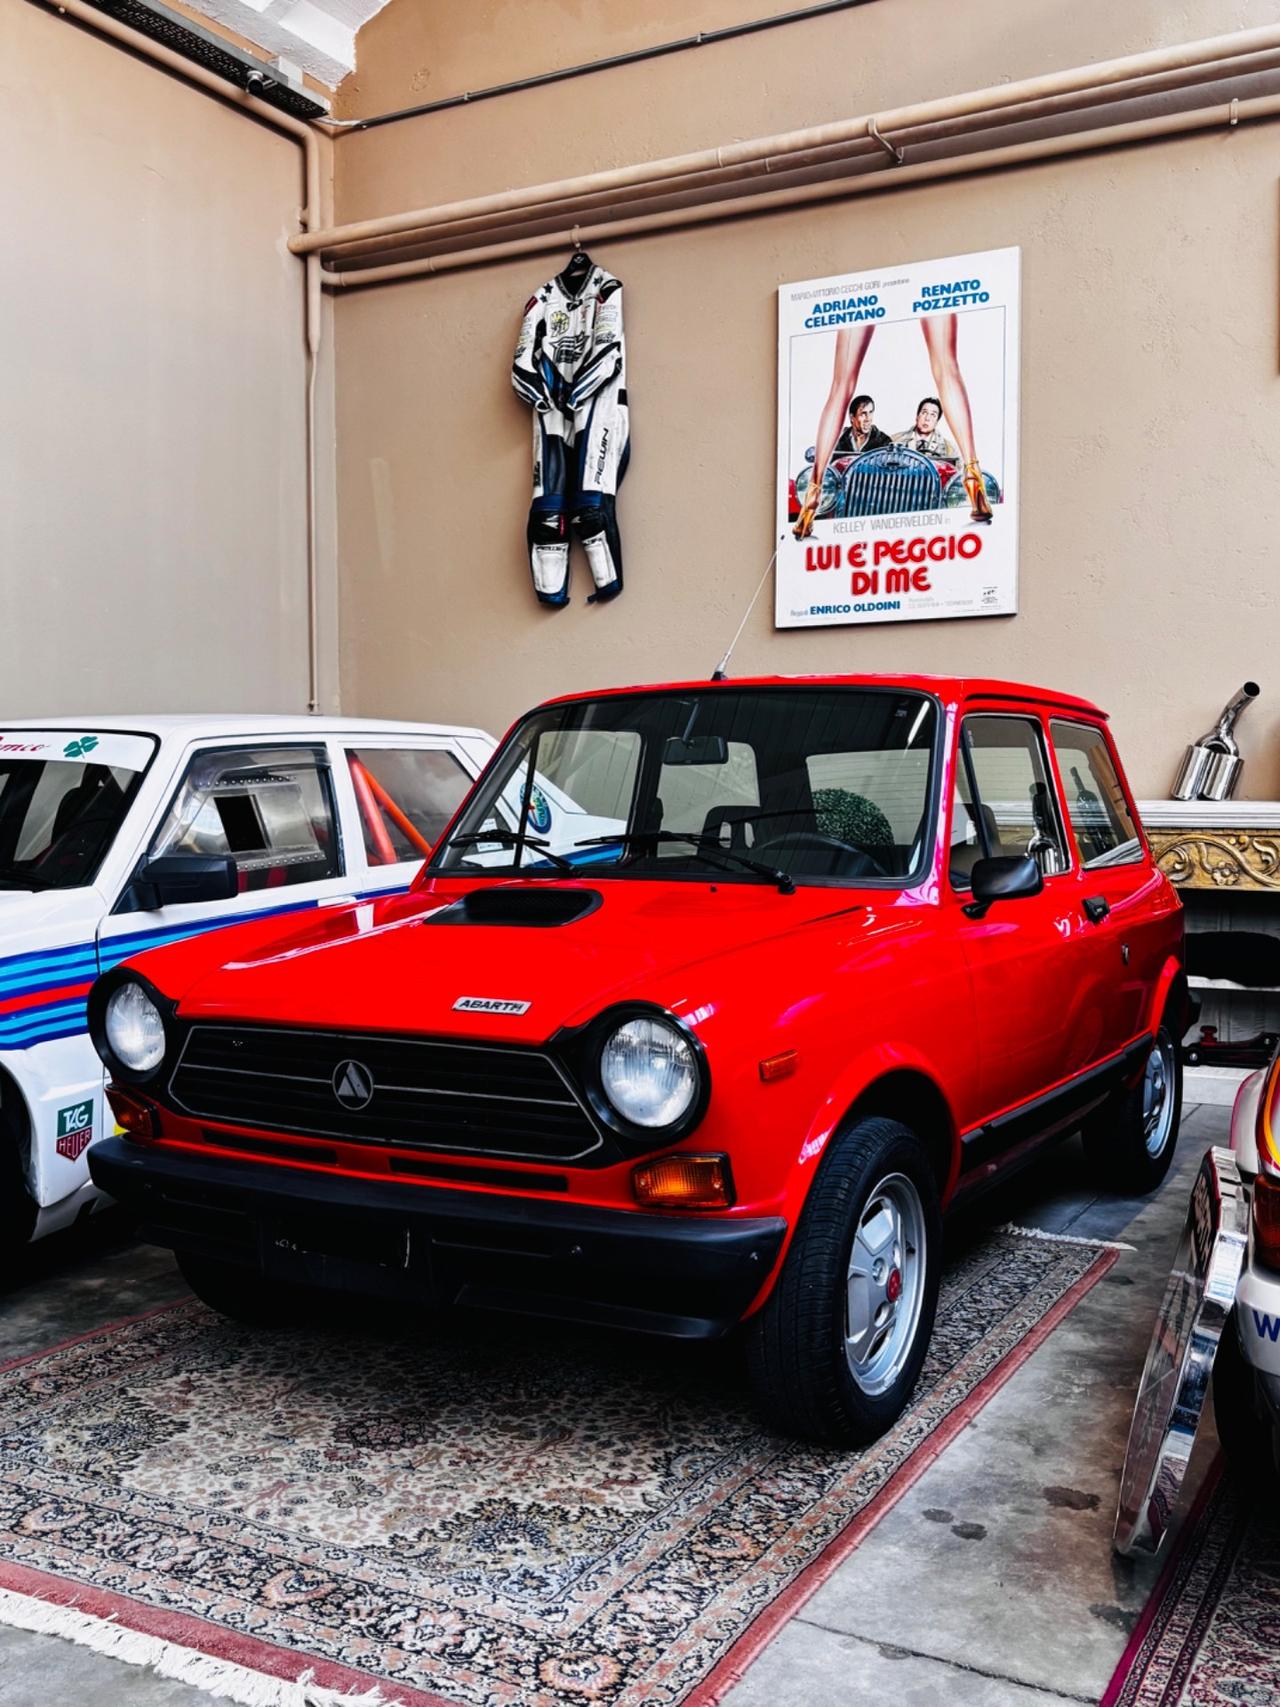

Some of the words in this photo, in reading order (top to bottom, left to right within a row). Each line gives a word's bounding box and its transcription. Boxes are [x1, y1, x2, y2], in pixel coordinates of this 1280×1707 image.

[922, 279, 981, 298] RENATO
[812, 295, 878, 315] ADRIANO
[912, 292, 990, 312] POZZETTO
[805, 307, 886, 329] CELENTANO
[833, 520, 866, 534] KELLEY
[870, 514, 943, 530] VANDERVELDEN
[806, 545, 841, 572] LUI
[874, 533, 983, 566] PEGGIO
[851, 569, 878, 596] DI
[885, 567, 931, 593] ME
[810, 605, 851, 615] ENRICO
[853, 601, 901, 612] OLDOINI
[459, 999, 525, 1012] ABARTH
[63, 1104, 89, 1132] TAG
[59, 1129, 91, 1158] HEUER
